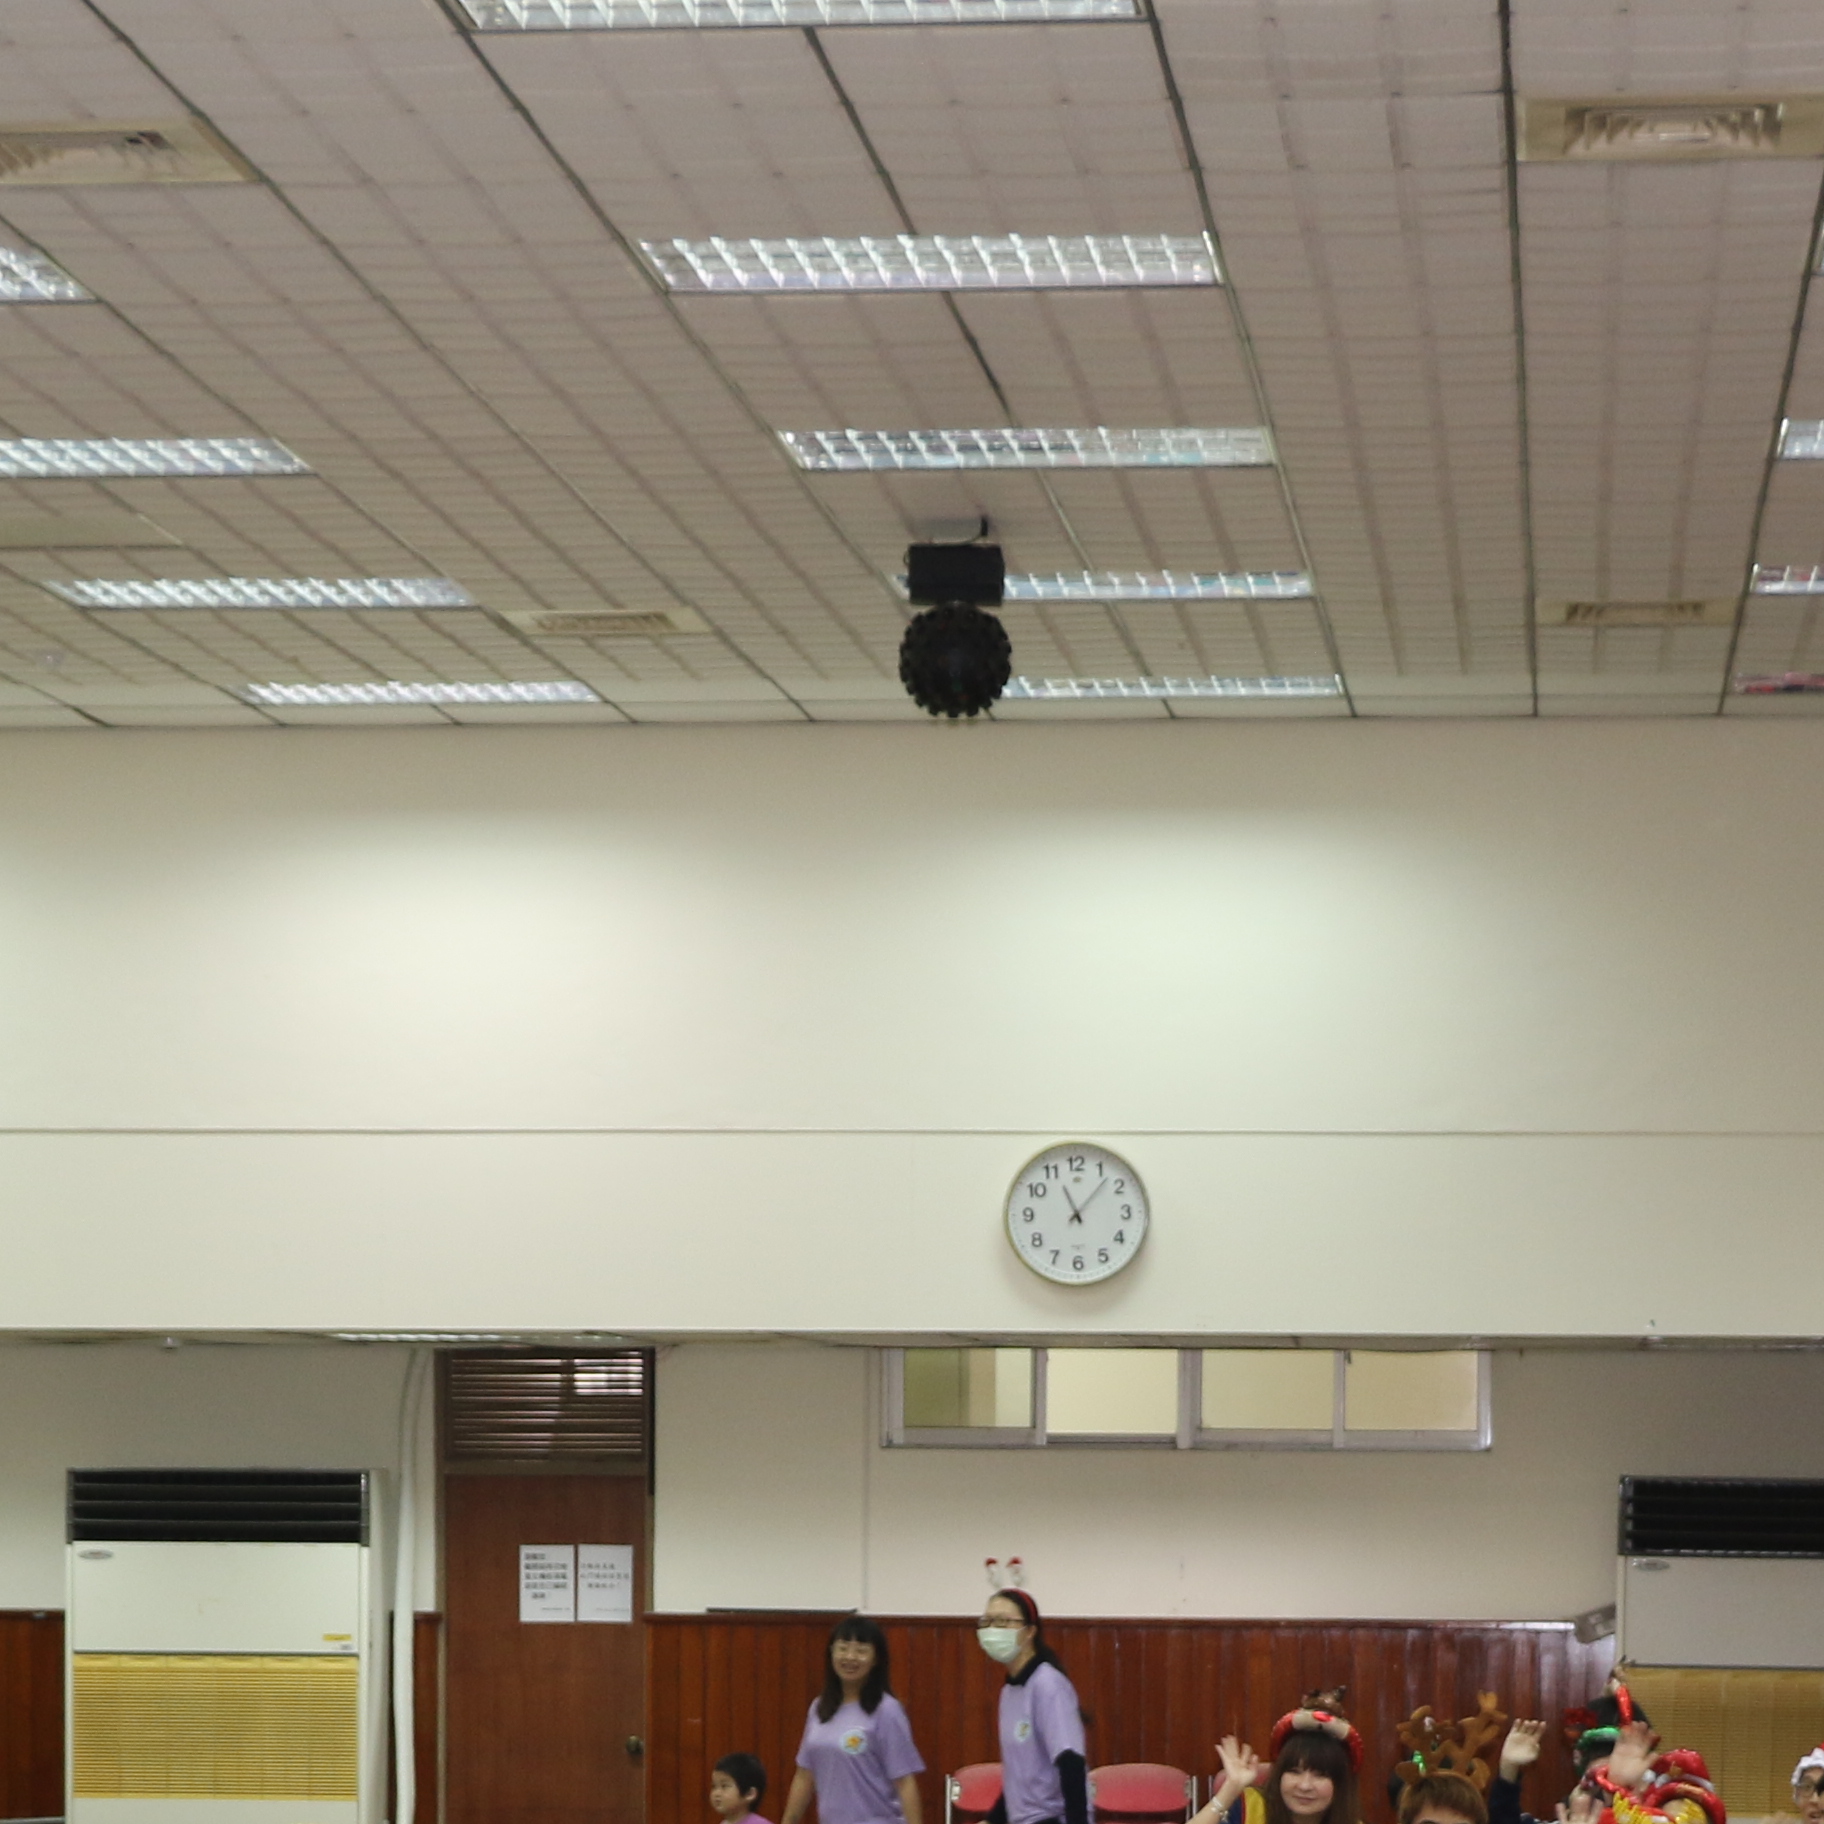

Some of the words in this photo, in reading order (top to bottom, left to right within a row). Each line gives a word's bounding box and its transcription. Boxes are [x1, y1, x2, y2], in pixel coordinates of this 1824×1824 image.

[1043, 1163, 1059, 1179] 11
[1067, 1156, 1085, 1172] 12
[1096, 1161, 1103, 1177] 1
[1027, 1182, 1046, 1198] 10
[1114, 1178, 1125, 1194] 2
[1023, 1207, 1034, 1222] 9
[1120, 1204, 1131, 1220] 3
[1031, 1232, 1042, 1247] 8
[1113, 1229, 1124, 1244] 4
[1050, 1250, 1060, 1265] 7
[1072, 1256, 1084, 1270] 6
[1098, 1248, 1109, 1263] 5
